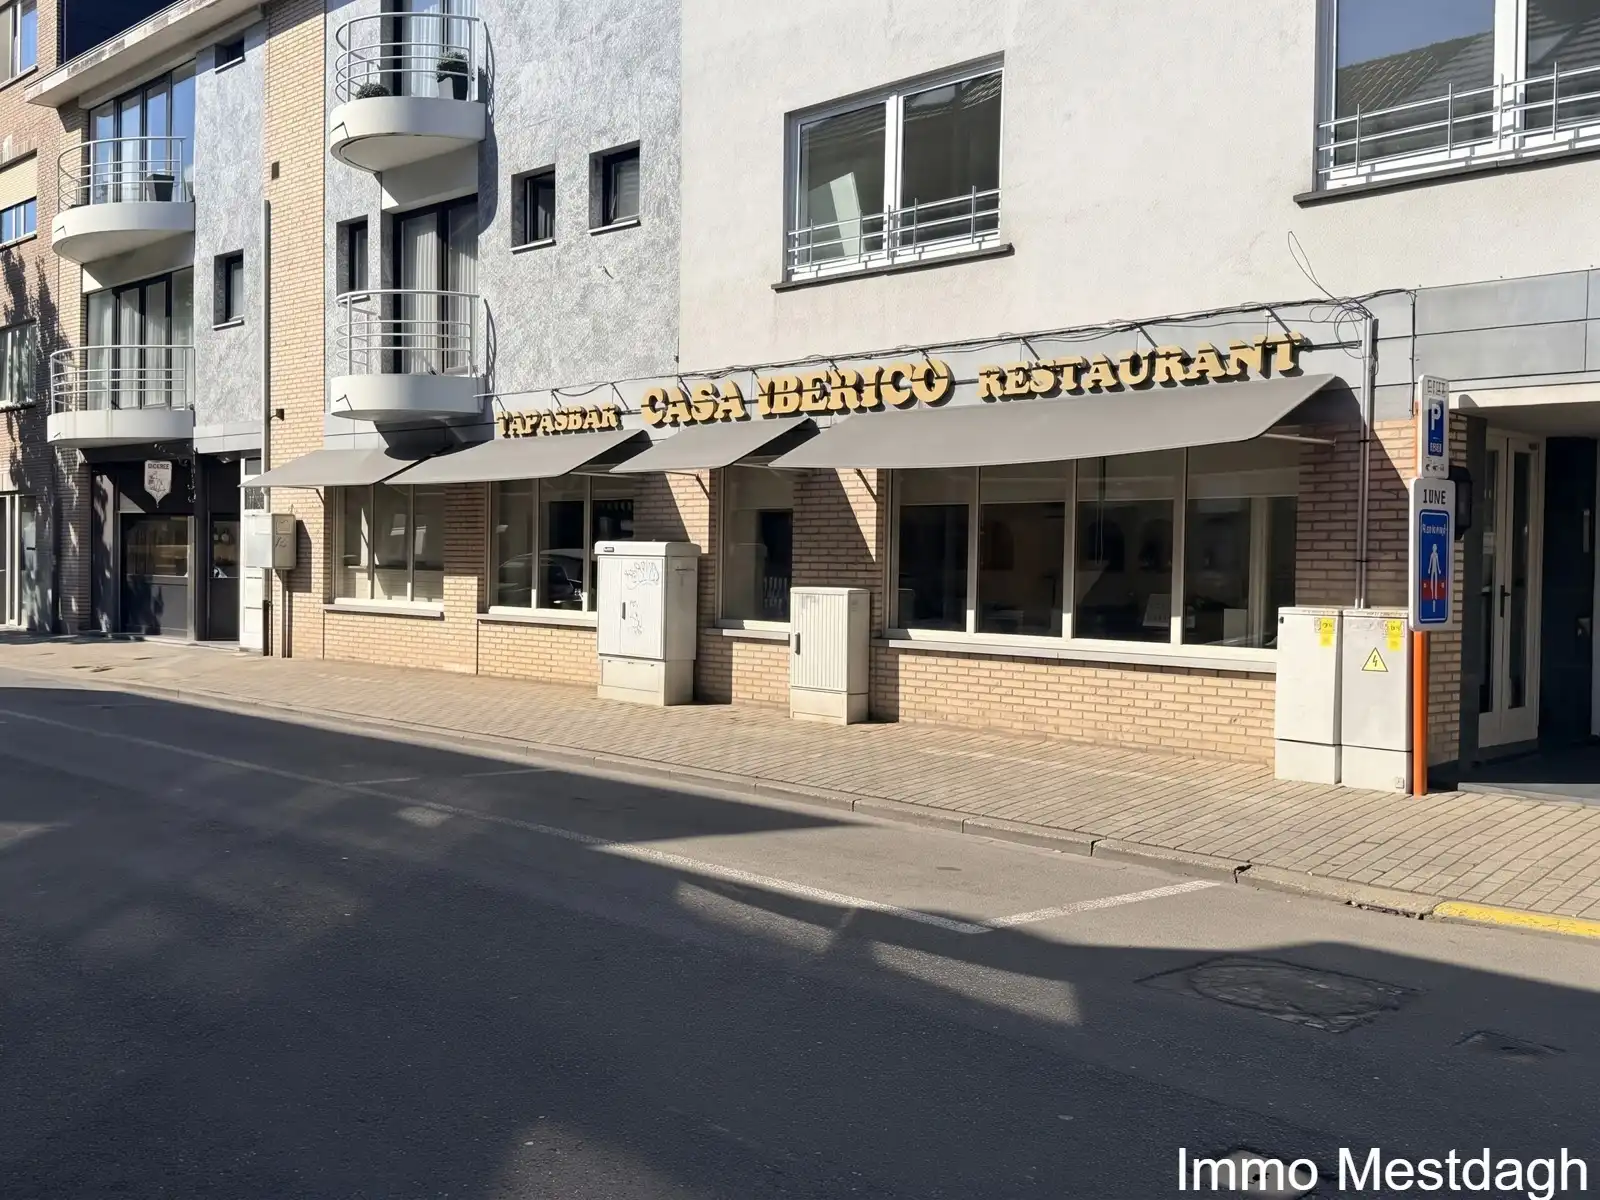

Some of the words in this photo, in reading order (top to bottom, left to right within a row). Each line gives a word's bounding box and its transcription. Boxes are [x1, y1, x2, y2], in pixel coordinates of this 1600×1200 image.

[641, 379, 747, 426] CASA
[757, 359, 951, 417] IBERICO
[976, 331, 1304, 400] RESTAURANT
[496, 403, 619, 437] TAPASBAR
